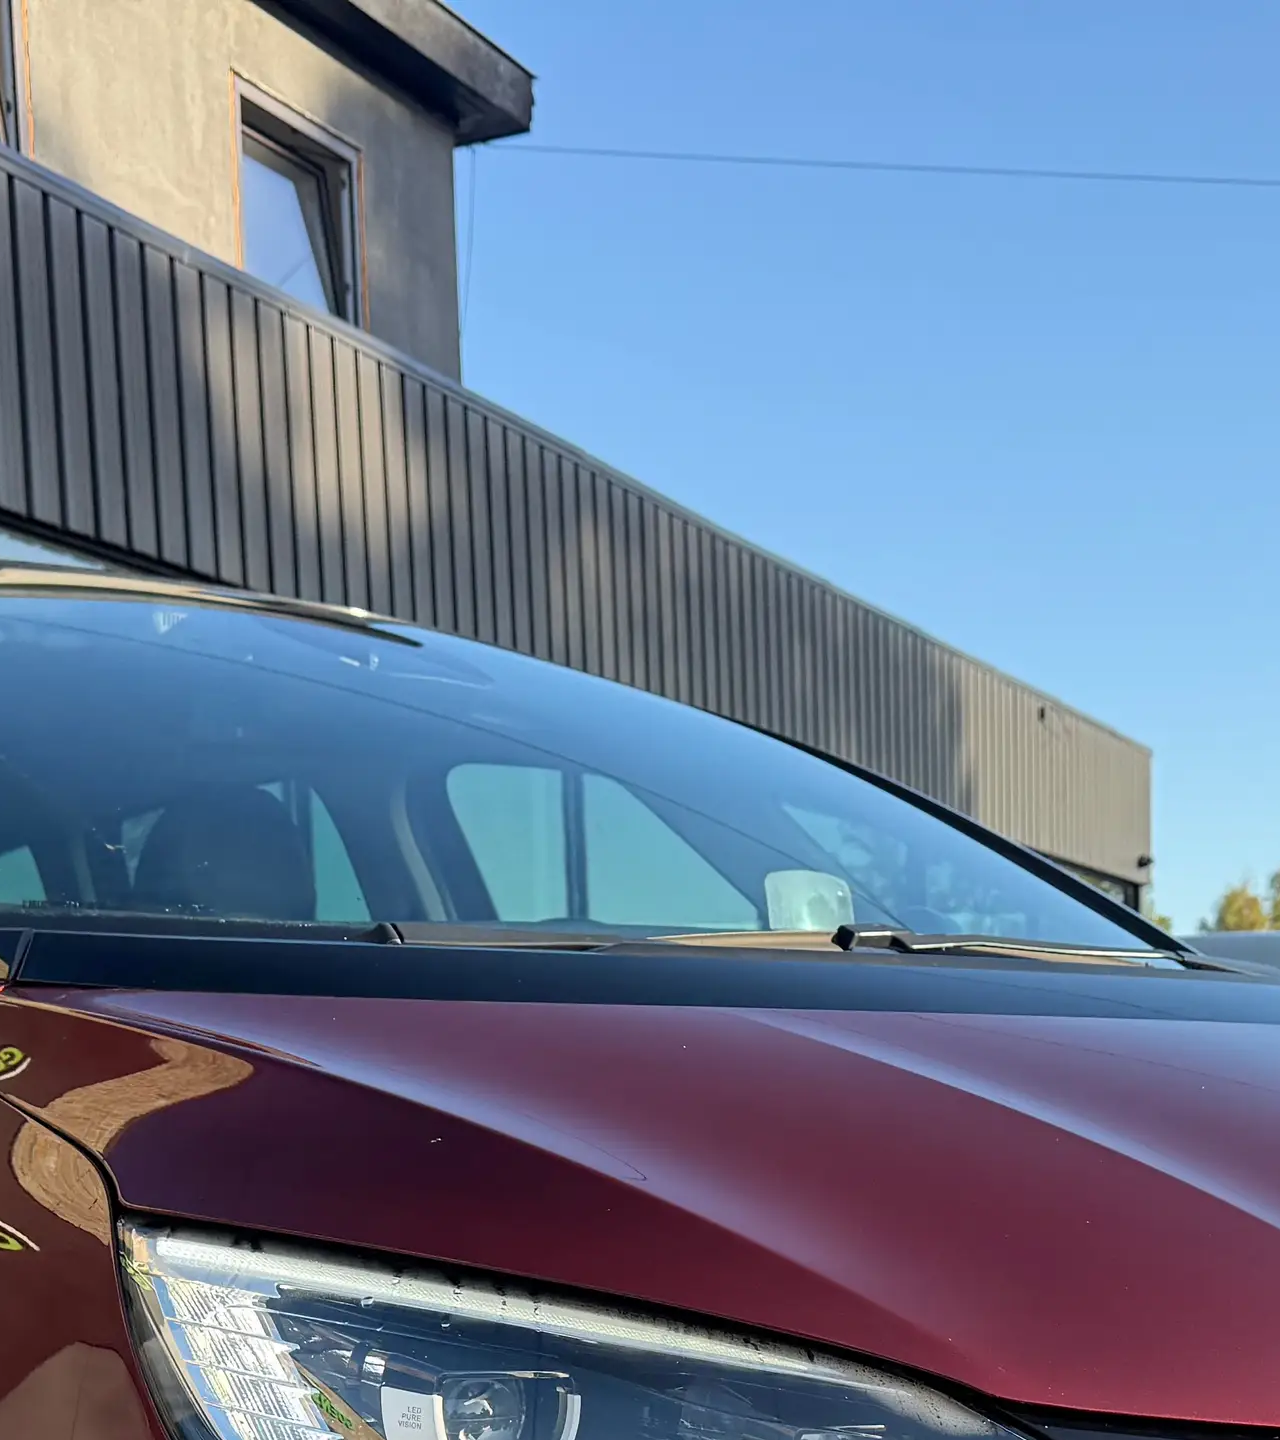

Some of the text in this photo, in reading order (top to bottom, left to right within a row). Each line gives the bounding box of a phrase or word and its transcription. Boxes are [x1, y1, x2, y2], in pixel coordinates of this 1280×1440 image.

[407, 1406, 422, 1414] LED
[401, 1413, 422, 1422] PURE
[398, 1420, 422, 1430] VISION
